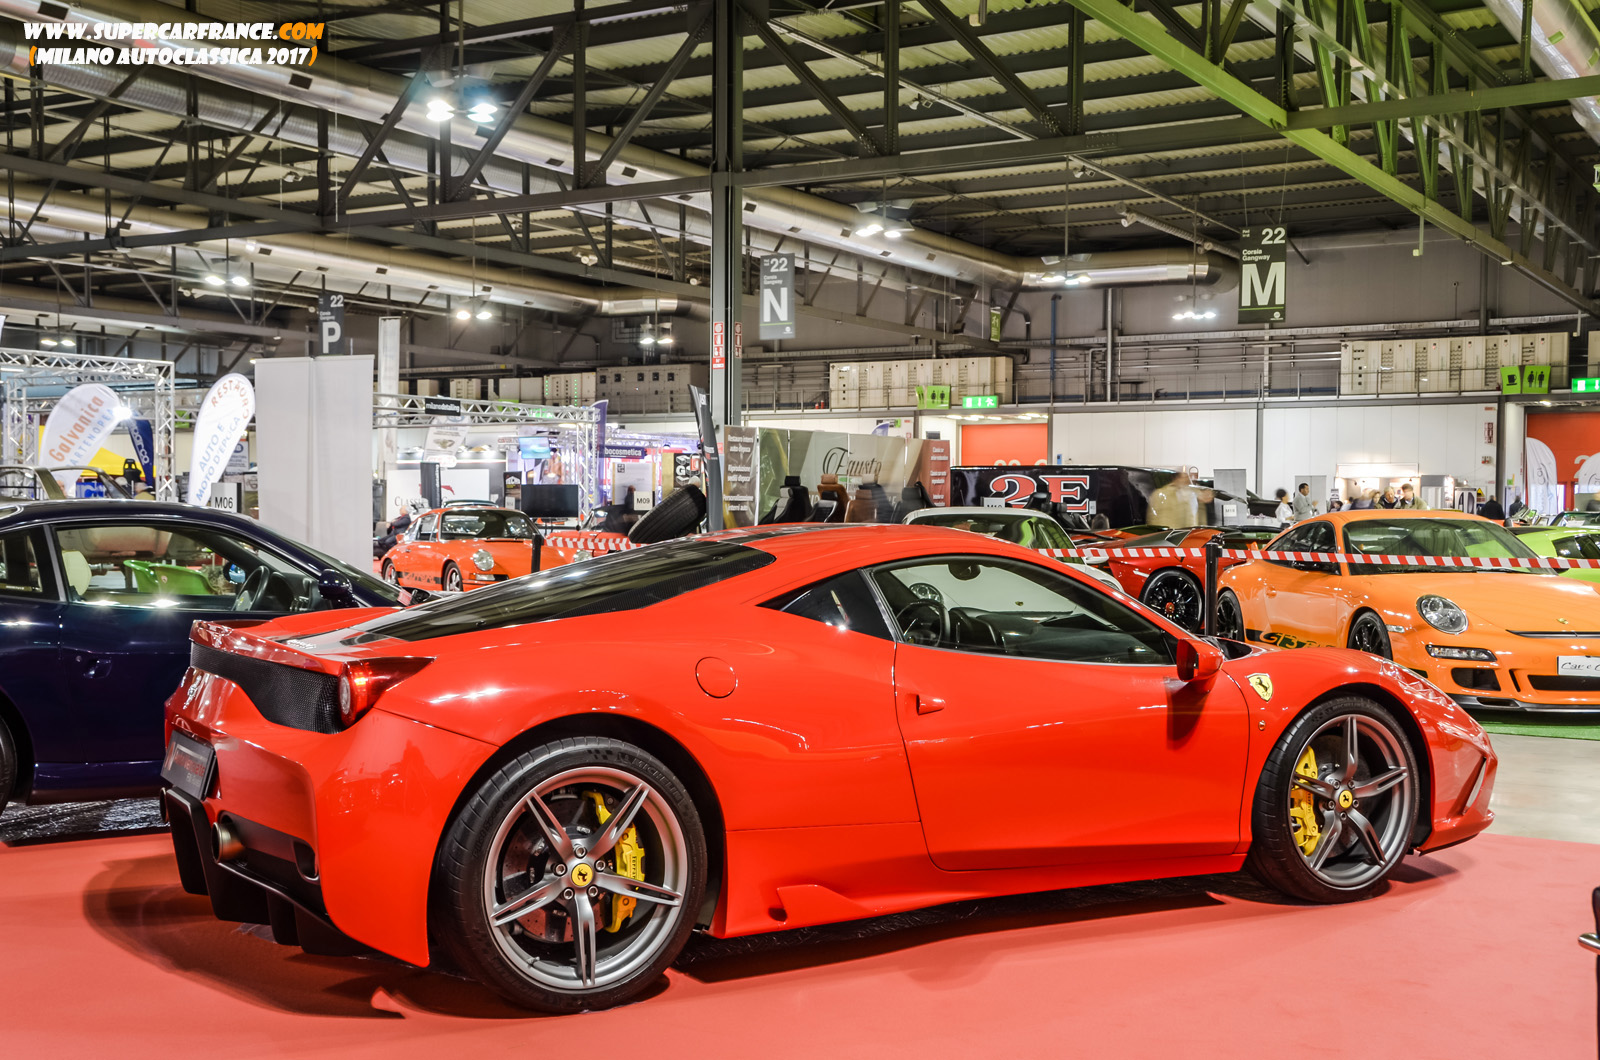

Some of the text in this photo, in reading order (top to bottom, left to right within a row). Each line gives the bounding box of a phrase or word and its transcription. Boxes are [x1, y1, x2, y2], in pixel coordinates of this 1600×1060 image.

[1261, 227, 1286, 245] 22
[770, 257, 788, 273] 22
[330, 294, 344, 307] 22
[1241, 262, 1286, 306] M
[763, 287, 788, 323] N
[322, 321, 341, 354] P
[211, 380, 250, 419] RESTAURO
[49, 396, 104, 462] Galvanica
[199, 423, 225, 472] AUTO E
[823, 446, 882, 477] Fausto
[195, 465, 215, 501] MOTO
[989, 473, 1090, 513] 2E
[214, 496, 234, 509] M06
[632, 757, 684, 801] MICHELIN
